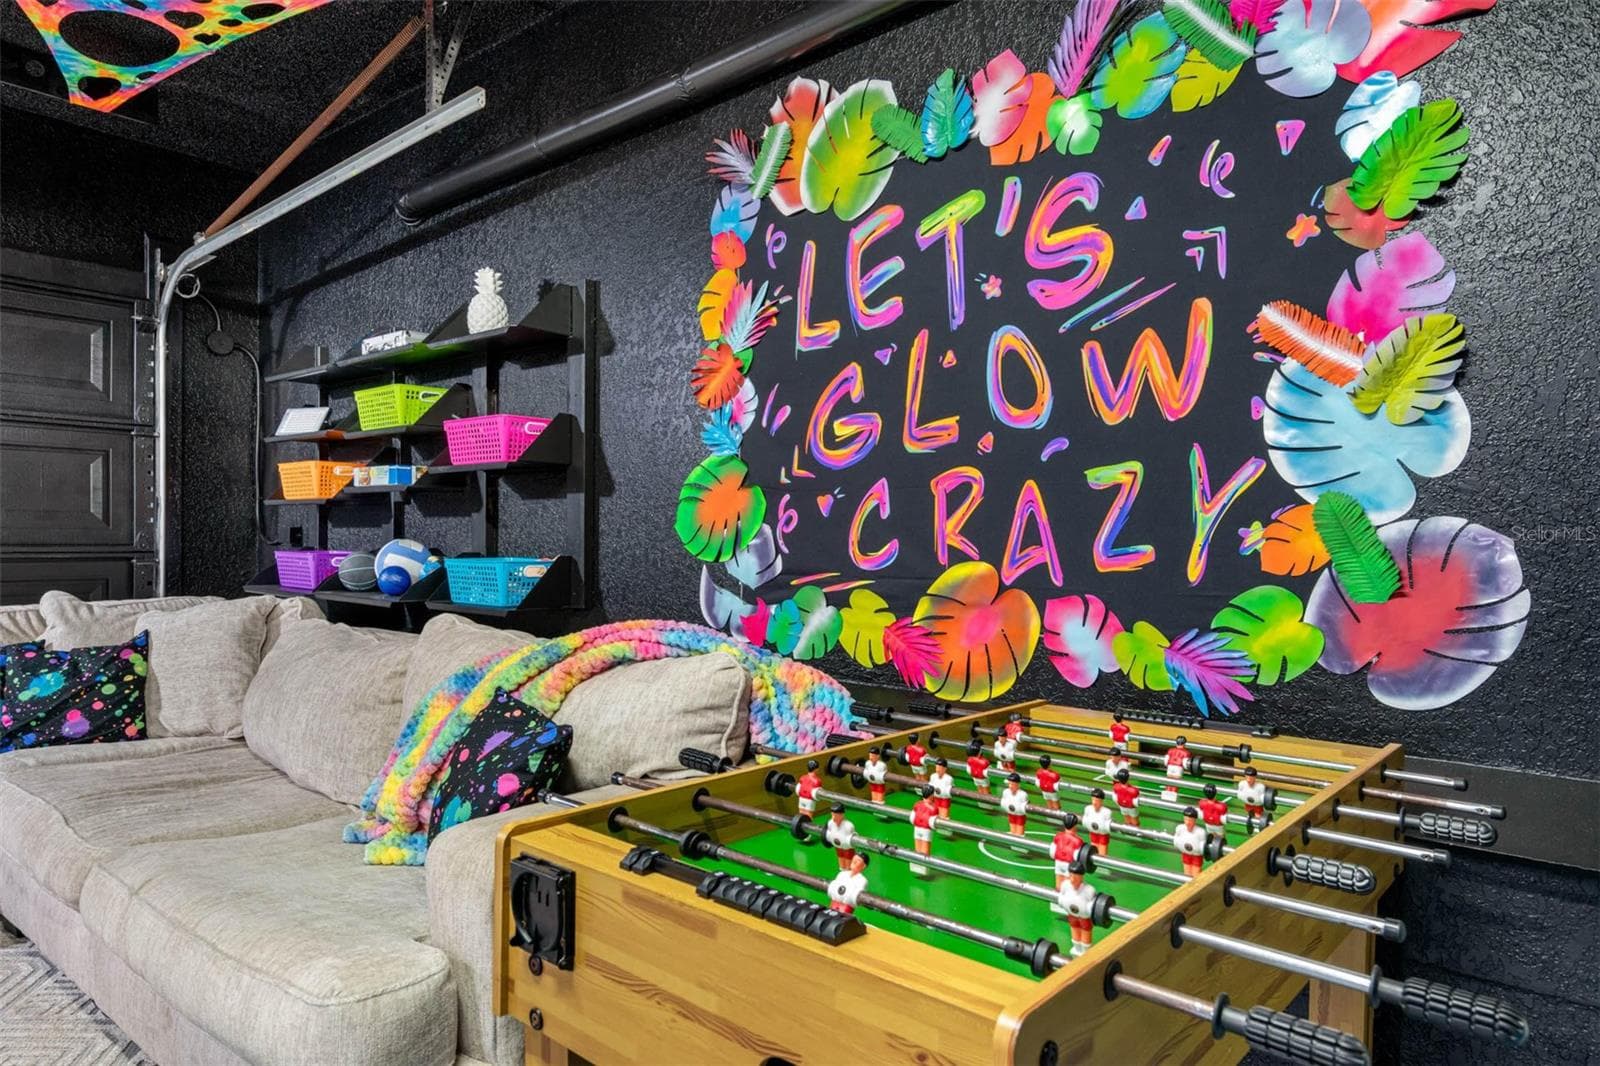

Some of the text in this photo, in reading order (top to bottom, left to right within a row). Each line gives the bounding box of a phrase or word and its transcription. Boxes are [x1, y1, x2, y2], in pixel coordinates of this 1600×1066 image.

[796, 172, 1114, 358] LET'S
[806, 298, 1213, 469] GLOW
[848, 443, 1266, 585] CRAZY
